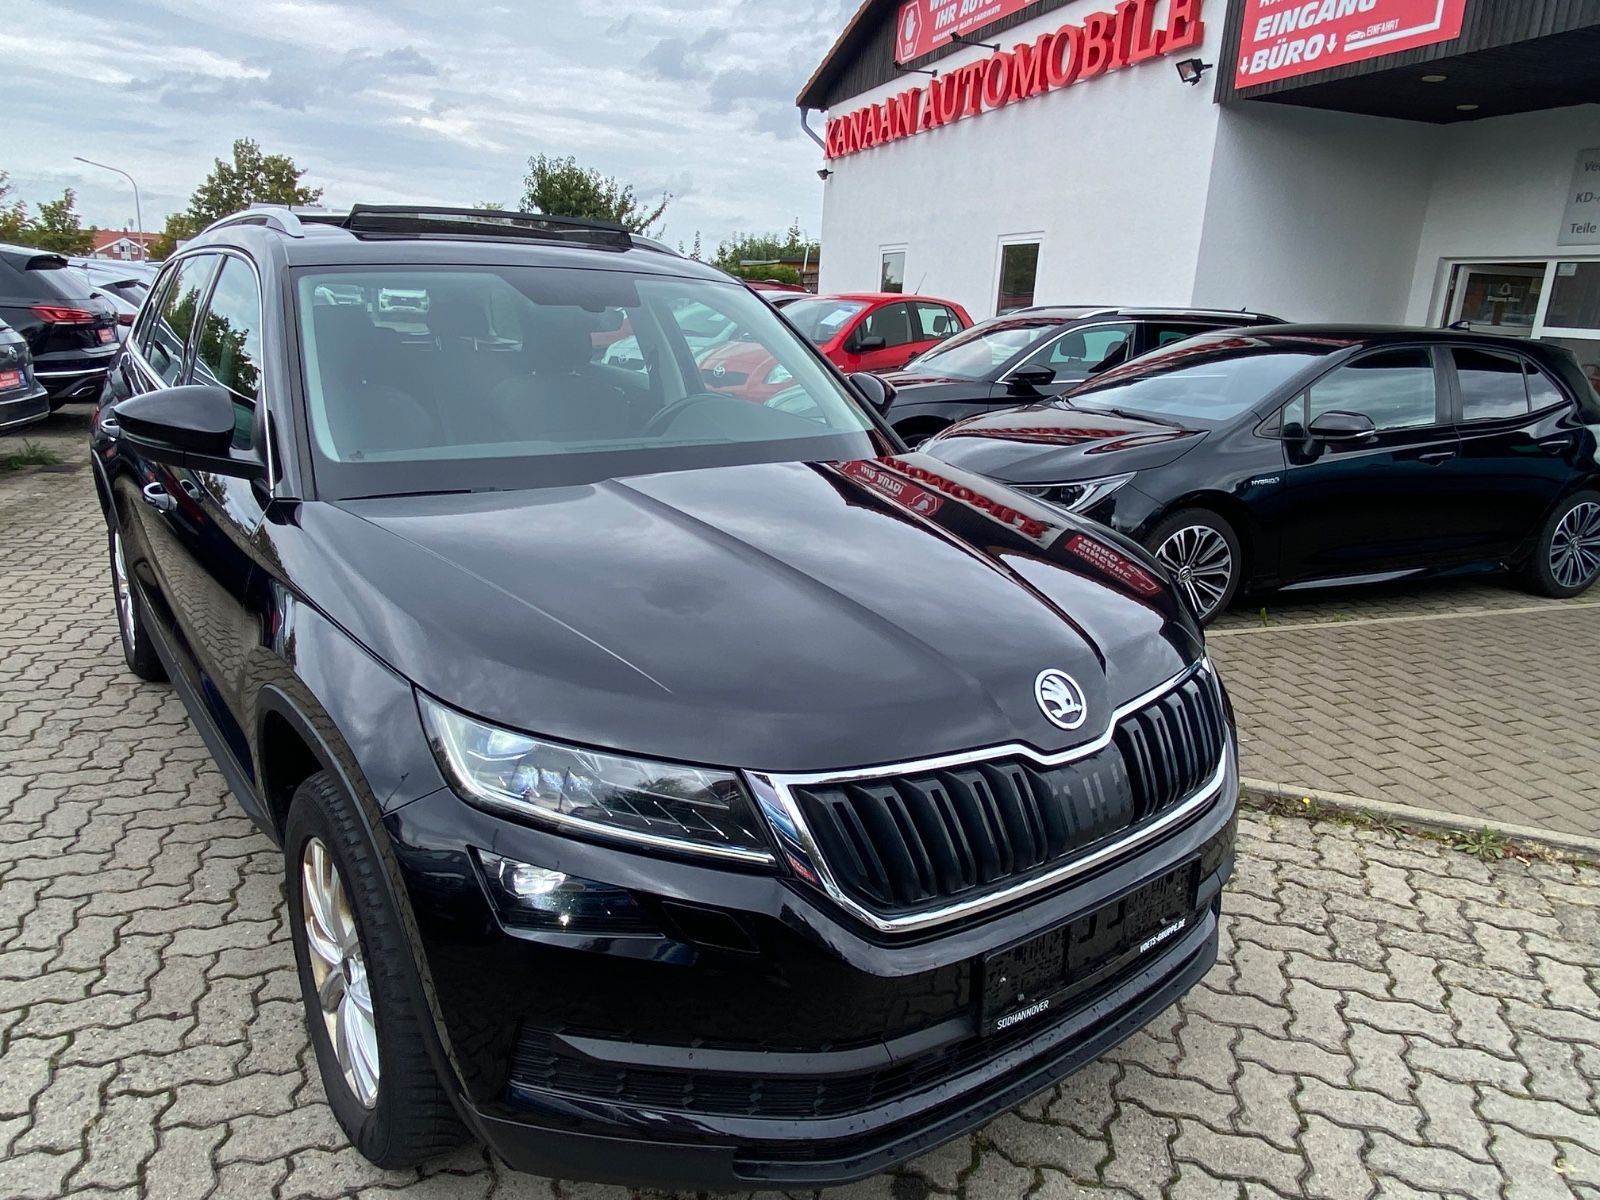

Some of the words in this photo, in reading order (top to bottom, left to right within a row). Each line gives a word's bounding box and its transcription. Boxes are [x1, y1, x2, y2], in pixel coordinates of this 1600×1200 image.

[935, 3, 958, 31] IHR
[1366, 18, 1400, 37] EINFAHRT
[1248, 33, 1325, 75] BÜRO
[824, 87, 921, 160] KANAAN
[921, 0, 1204, 131] AUTOMOBILE
[1570, 222, 1597, 234] Teile
